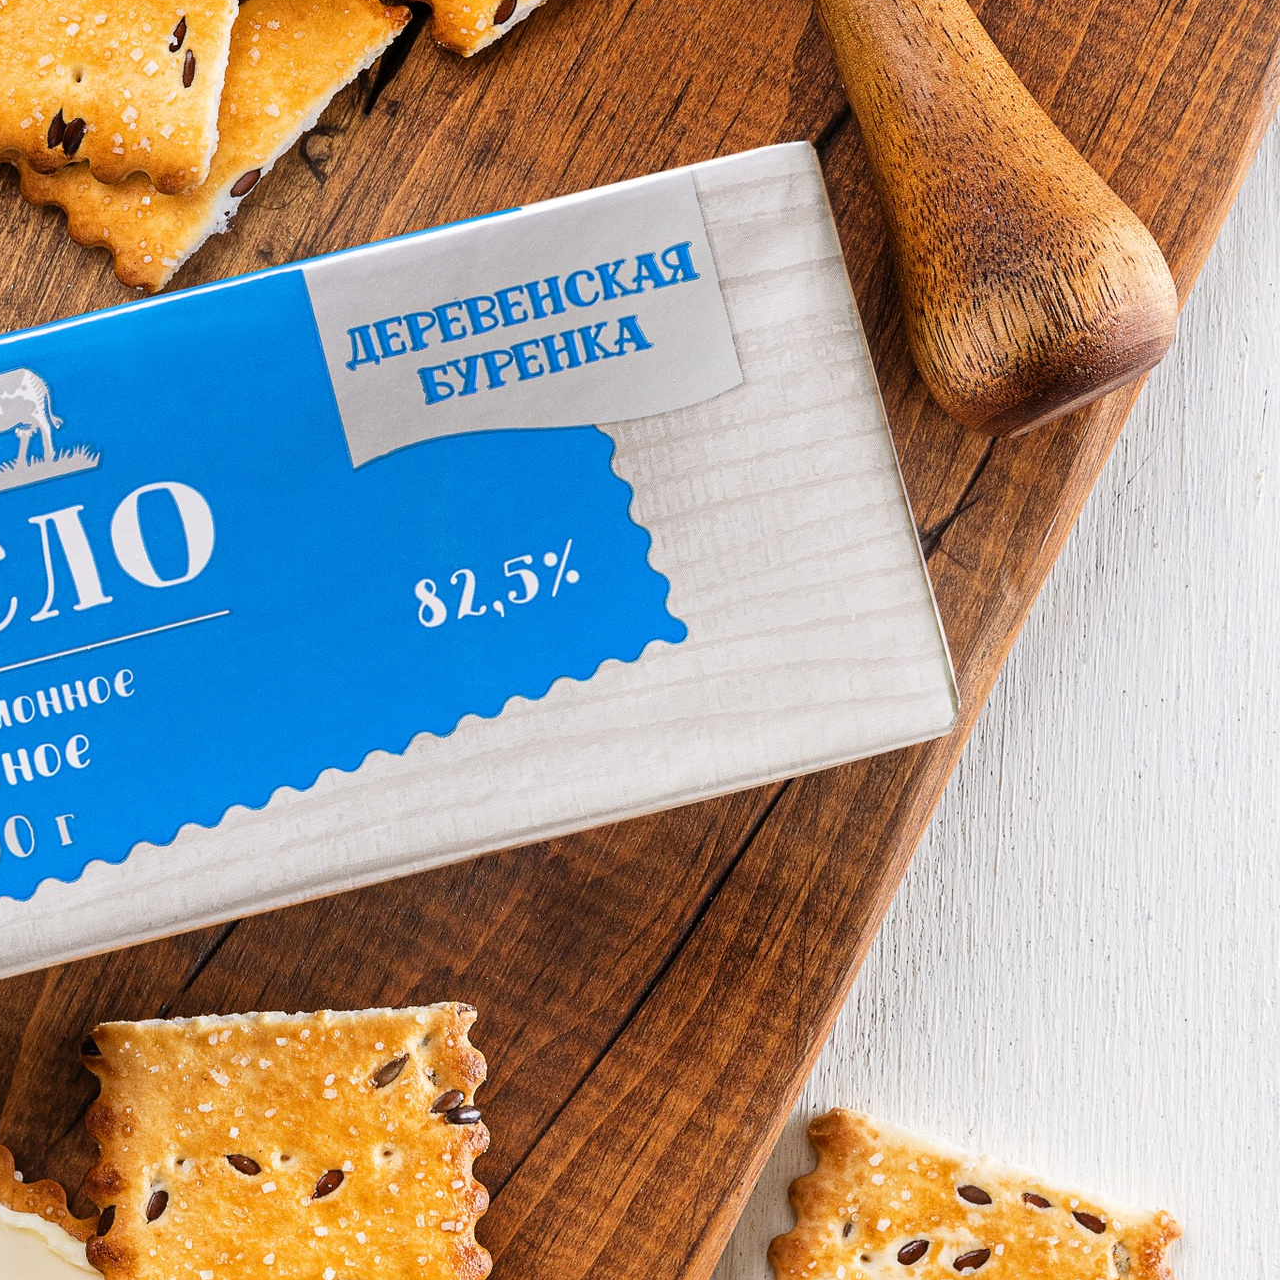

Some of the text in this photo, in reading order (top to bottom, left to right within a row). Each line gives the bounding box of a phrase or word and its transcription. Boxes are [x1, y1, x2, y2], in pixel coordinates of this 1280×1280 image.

[345, 241, 701, 370] ДЕРЕВЕНСКАЯ
[417, 315, 655, 406] БУРЕНКА
[413, 538, 580, 628] 82,5%
[55, 813, 77, 848] г
